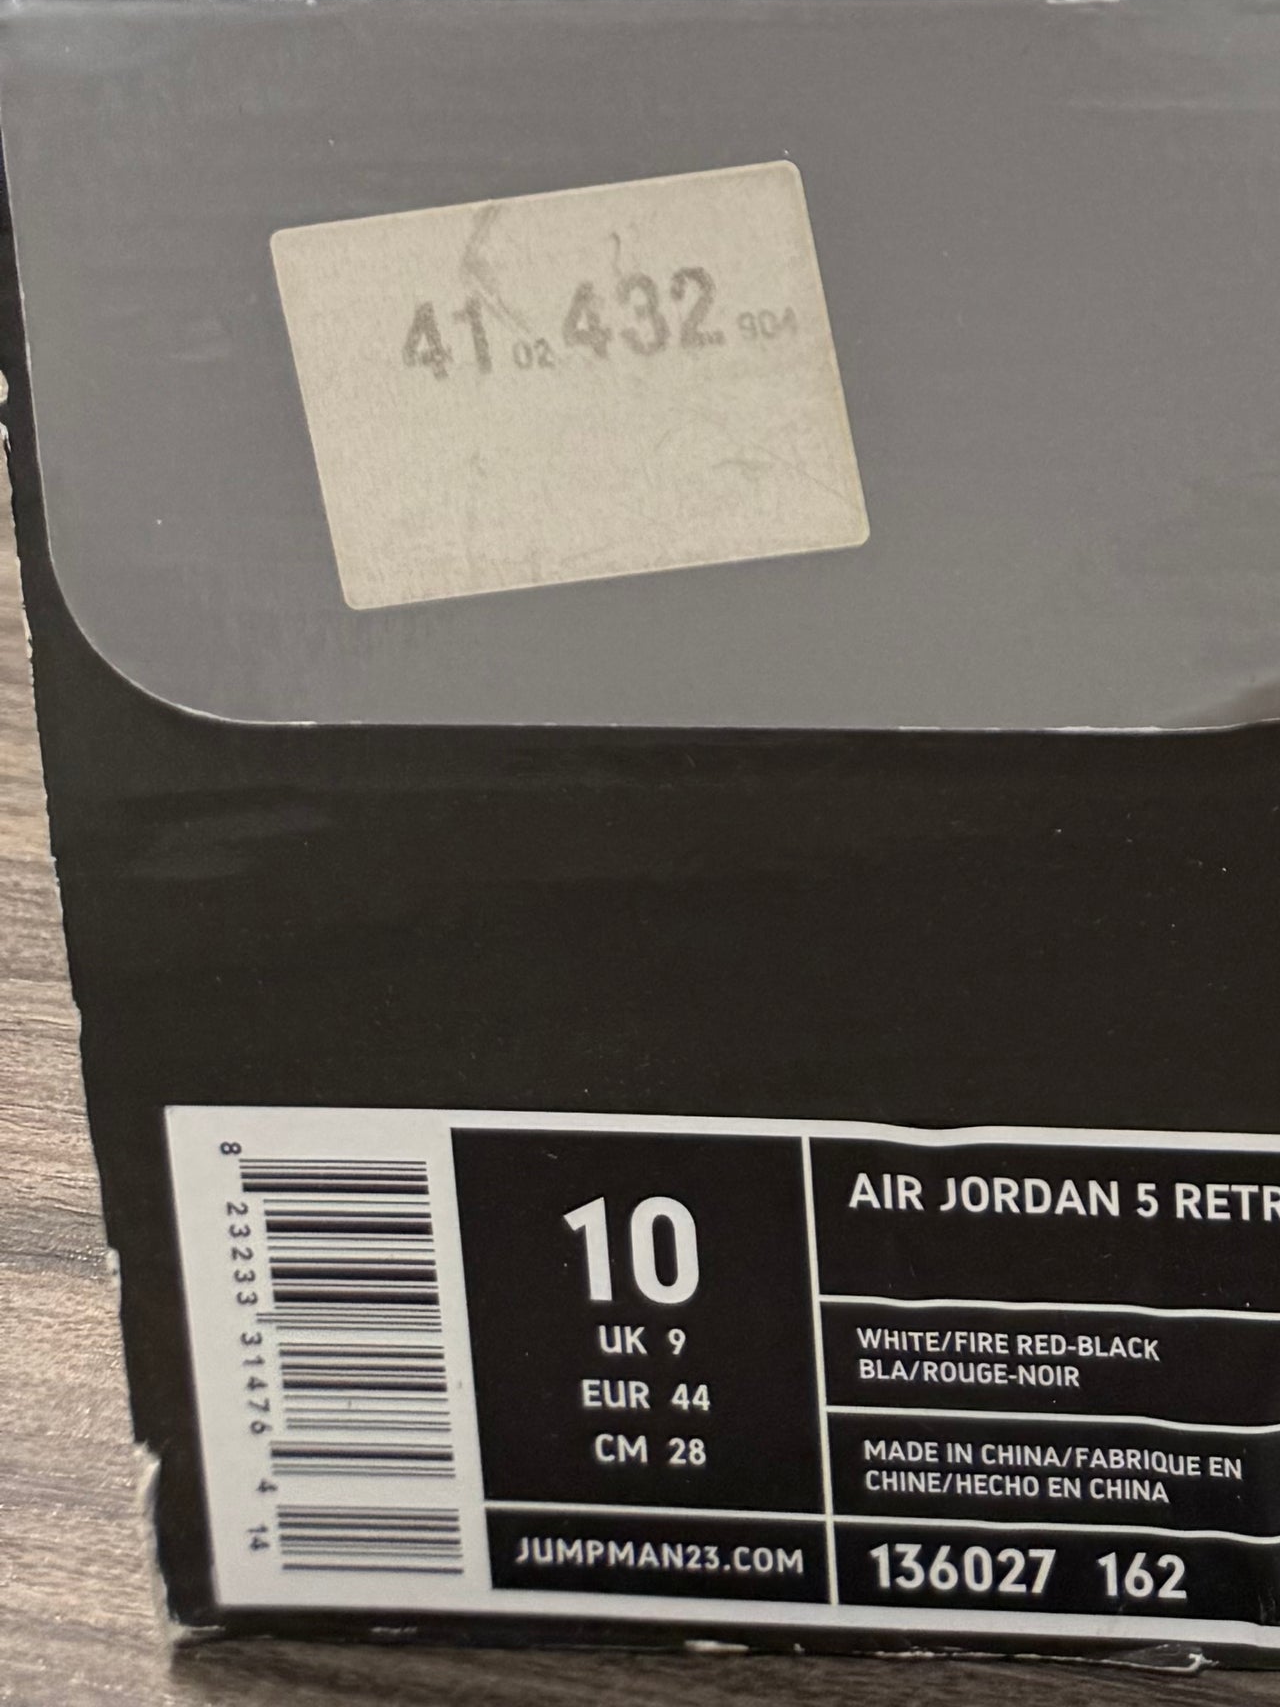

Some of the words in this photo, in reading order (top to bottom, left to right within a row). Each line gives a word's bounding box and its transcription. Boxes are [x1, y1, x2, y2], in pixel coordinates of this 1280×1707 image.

[402, 300, 494, 380] 41
[561, 266, 726, 361] 432
[219, 1141, 242, 1156] 8
[848, 1172, 924, 1211] AIR
[939, 1175, 1120, 1218] JORDAN
[1136, 1181, 1159, 1218] 5
[226, 1201, 258, 1307] 23233
[563, 1196, 700, 1305] 10
[598, 1325, 648, 1356] UK
[667, 1328, 686, 1356] 9
[857, 1327, 1010, 1355] WHITE/FIRE
[1016, 1333, 1161, 1362] RED-BLACK
[859, 1359, 1080, 1387] BLA/ROUGE-NOIR
[581, 1379, 651, 1410] EUR
[671, 1383, 711, 1412] 44
[594, 1433, 648, 1464] CM
[668, 1437, 707, 1466] 28
[864, 1440, 939, 1463] MADE
[947, 1443, 973, 1465] IN
[981, 1444, 1201, 1475] CHINA/FABRIQUE
[1209, 1457, 1242, 1480] EN
[865, 1470, 1040, 1498] CHINE/HECHO
[1048, 1477, 1081, 1499] EN
[1090, 1479, 1170, 1504] CHINA
[516, 1537, 804, 1574] JUMPMAN23.COM
[869, 1543, 1057, 1594] 136027
[1097, 1551, 1188, 1600] 162
